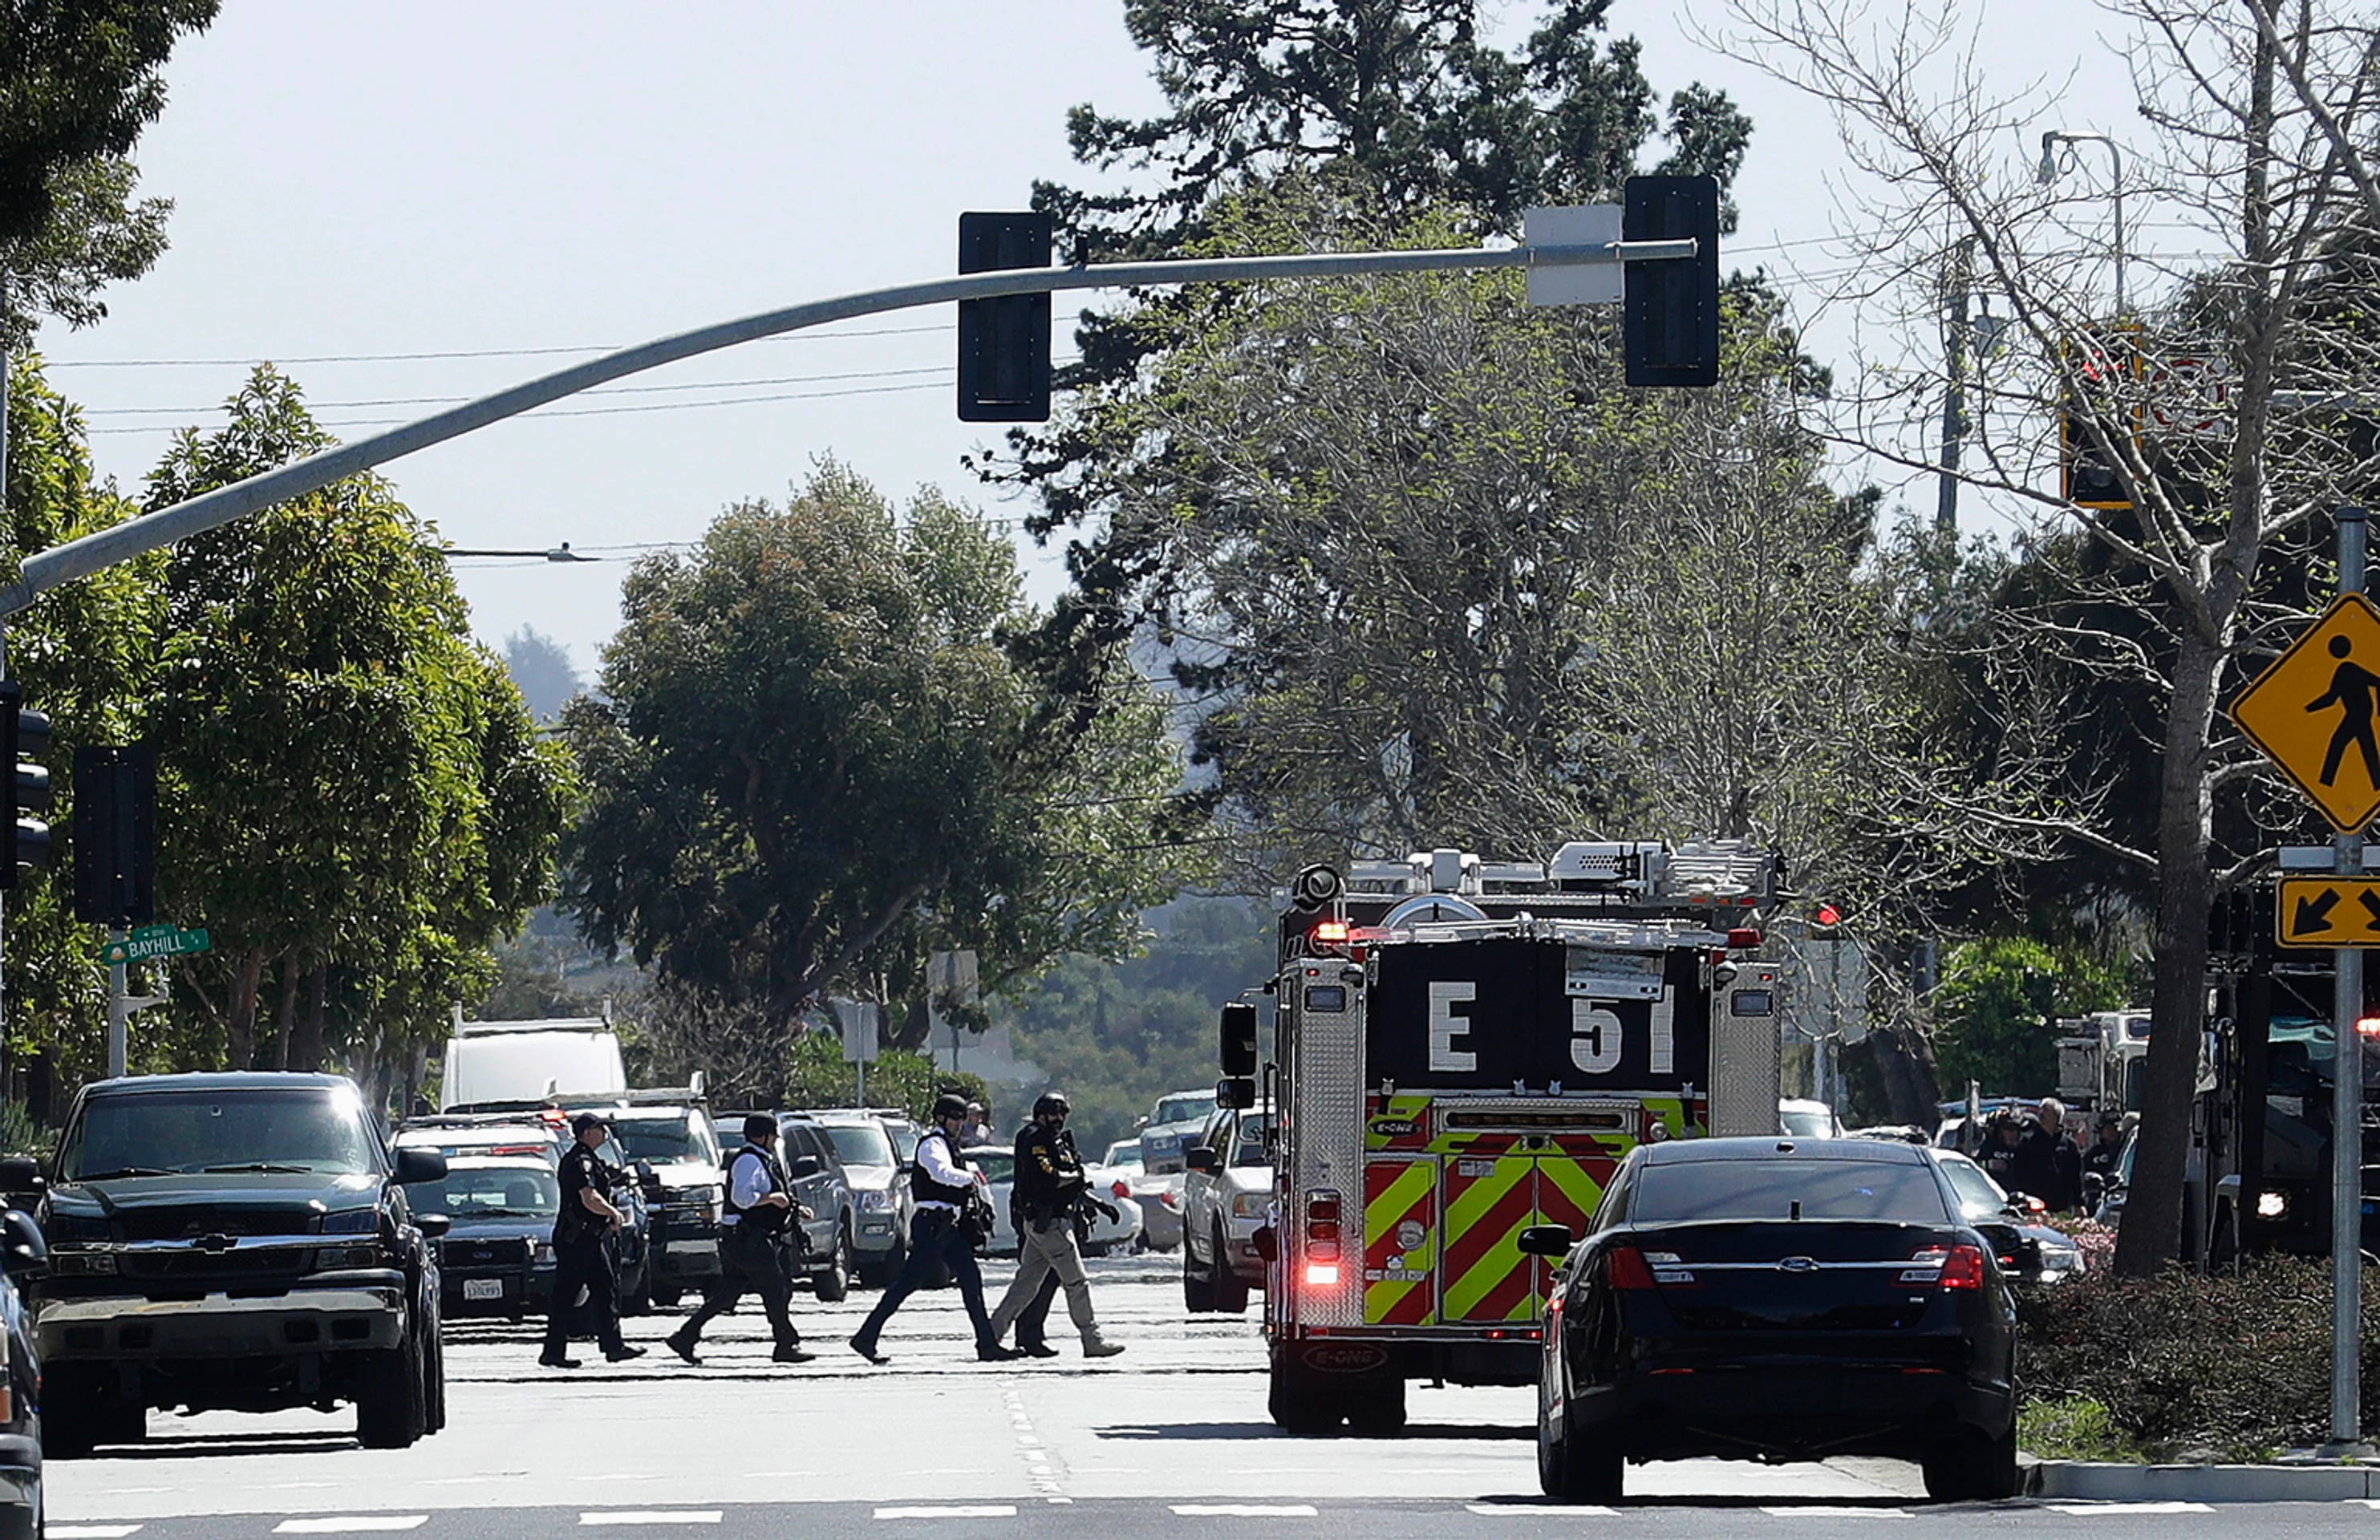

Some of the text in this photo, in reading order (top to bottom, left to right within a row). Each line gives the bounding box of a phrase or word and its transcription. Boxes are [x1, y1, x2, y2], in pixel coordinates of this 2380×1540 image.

[128, 934, 184, 958] BAYHILL
[1429, 981, 1675, 1074] E 51
